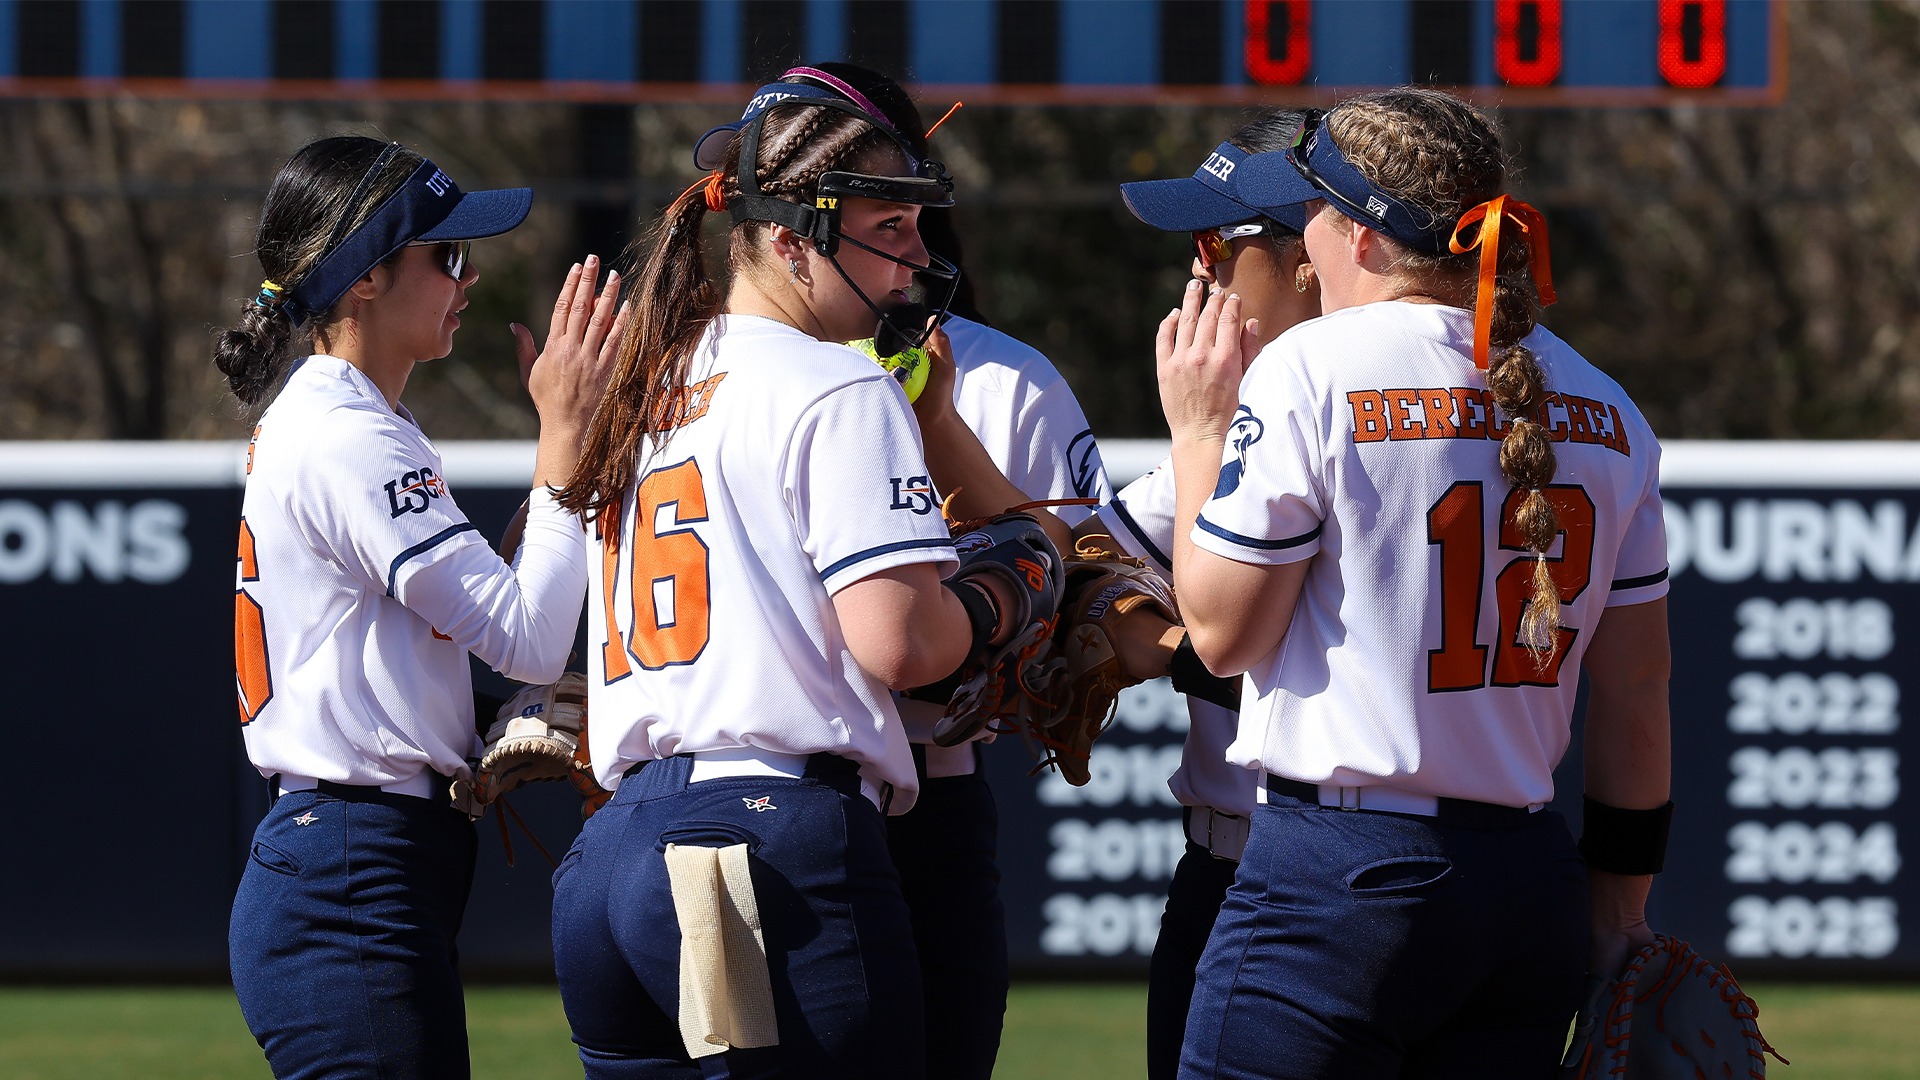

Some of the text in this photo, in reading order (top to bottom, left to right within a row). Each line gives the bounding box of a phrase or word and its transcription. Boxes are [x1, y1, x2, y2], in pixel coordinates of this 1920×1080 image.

[1201, 151, 1236, 182] LER
[1346, 387, 1630, 458] BERECCHEA
[595, 455, 712, 687] 16
[1426, 480, 1596, 694] 12
[1726, 671, 1901, 735] 2022
[1727, 746, 1901, 810] 2023
[1724, 820, 1902, 884] 2024
[1725, 895, 1900, 959] 2025
